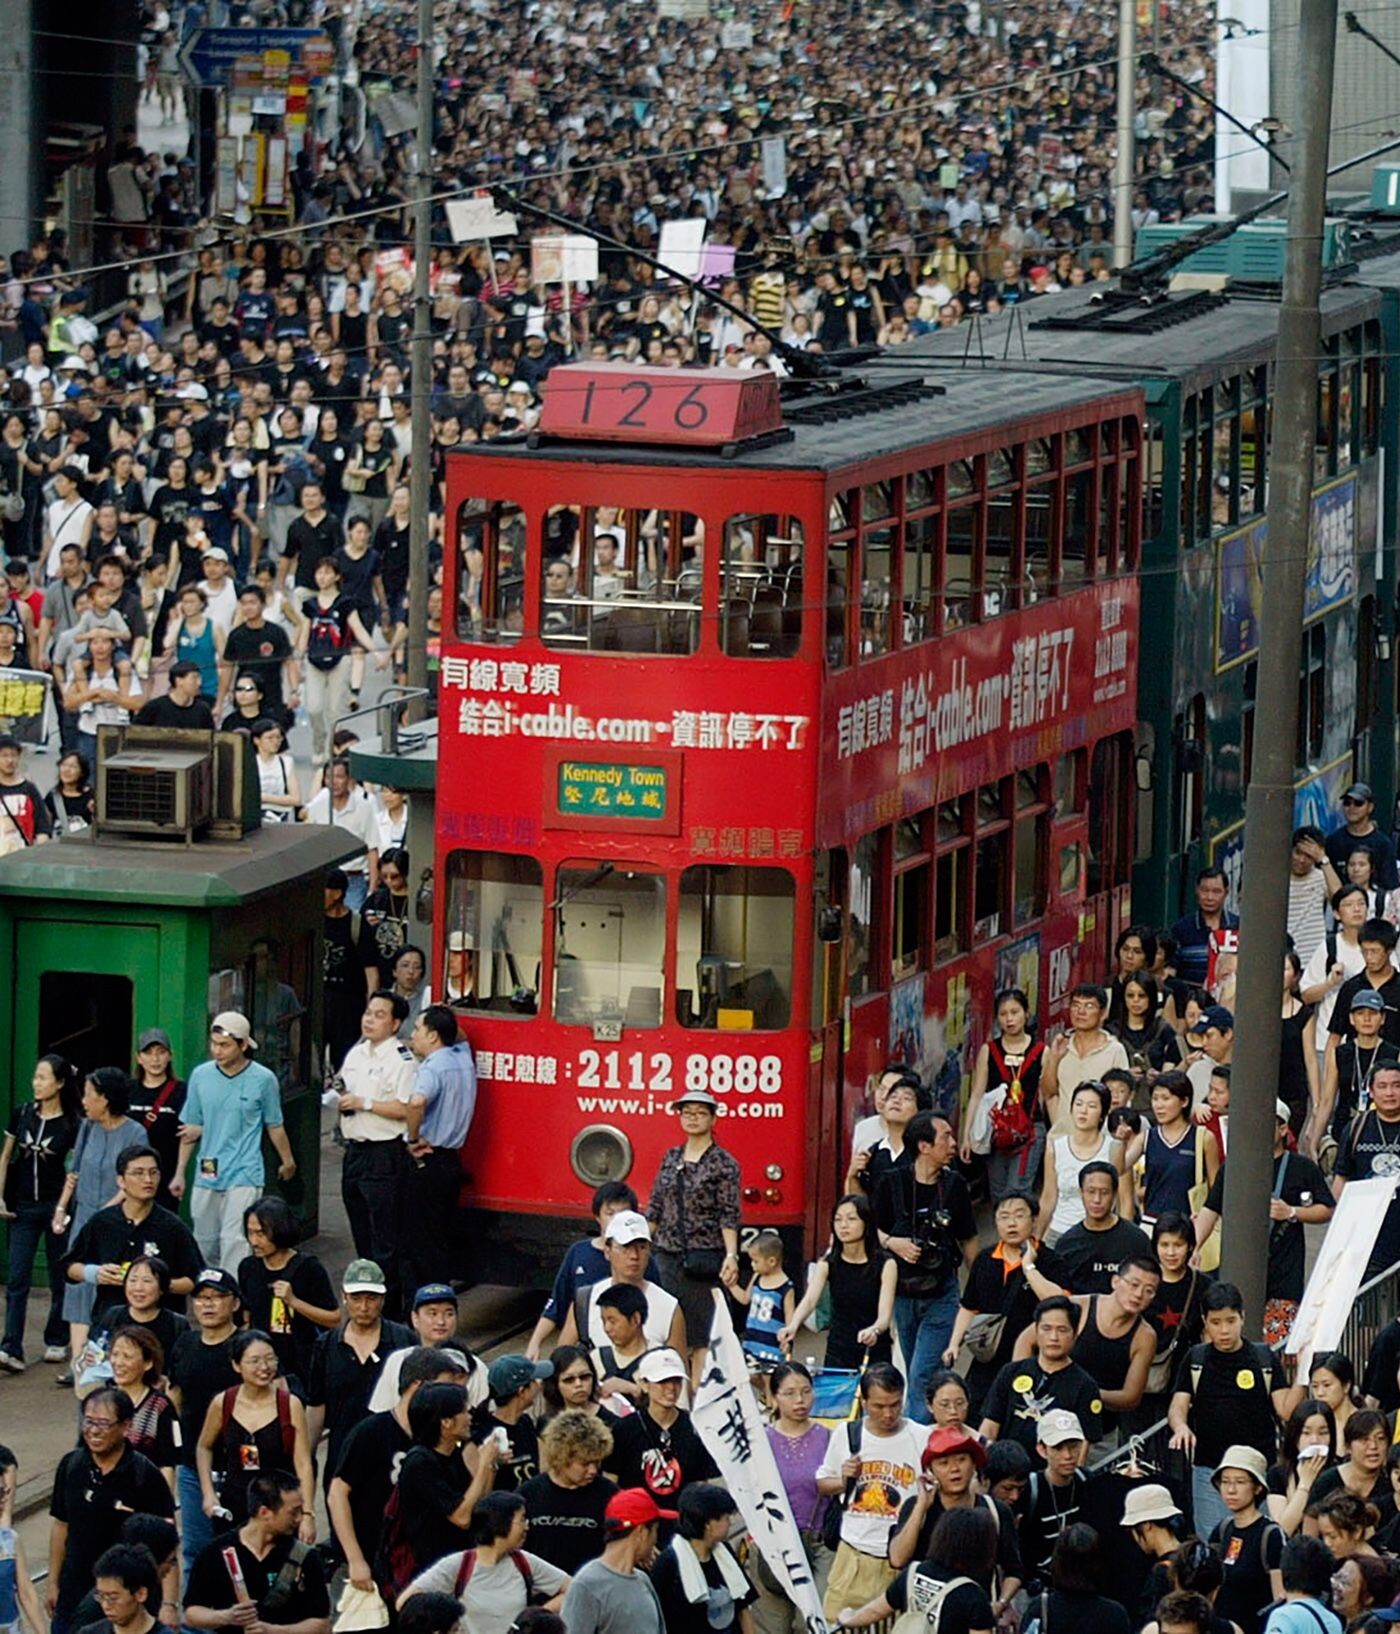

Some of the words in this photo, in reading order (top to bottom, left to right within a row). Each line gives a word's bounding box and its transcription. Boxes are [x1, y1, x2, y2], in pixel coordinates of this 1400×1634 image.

[581, 380, 708, 429] 126
[440, 656, 561, 696] 有線寬頻
[563, 763, 622, 786] Kennedy
[628, 767, 664, 786] Town
[577, 1050, 672, 1091] 2112
[685, 1054, 782, 1093] 8888
